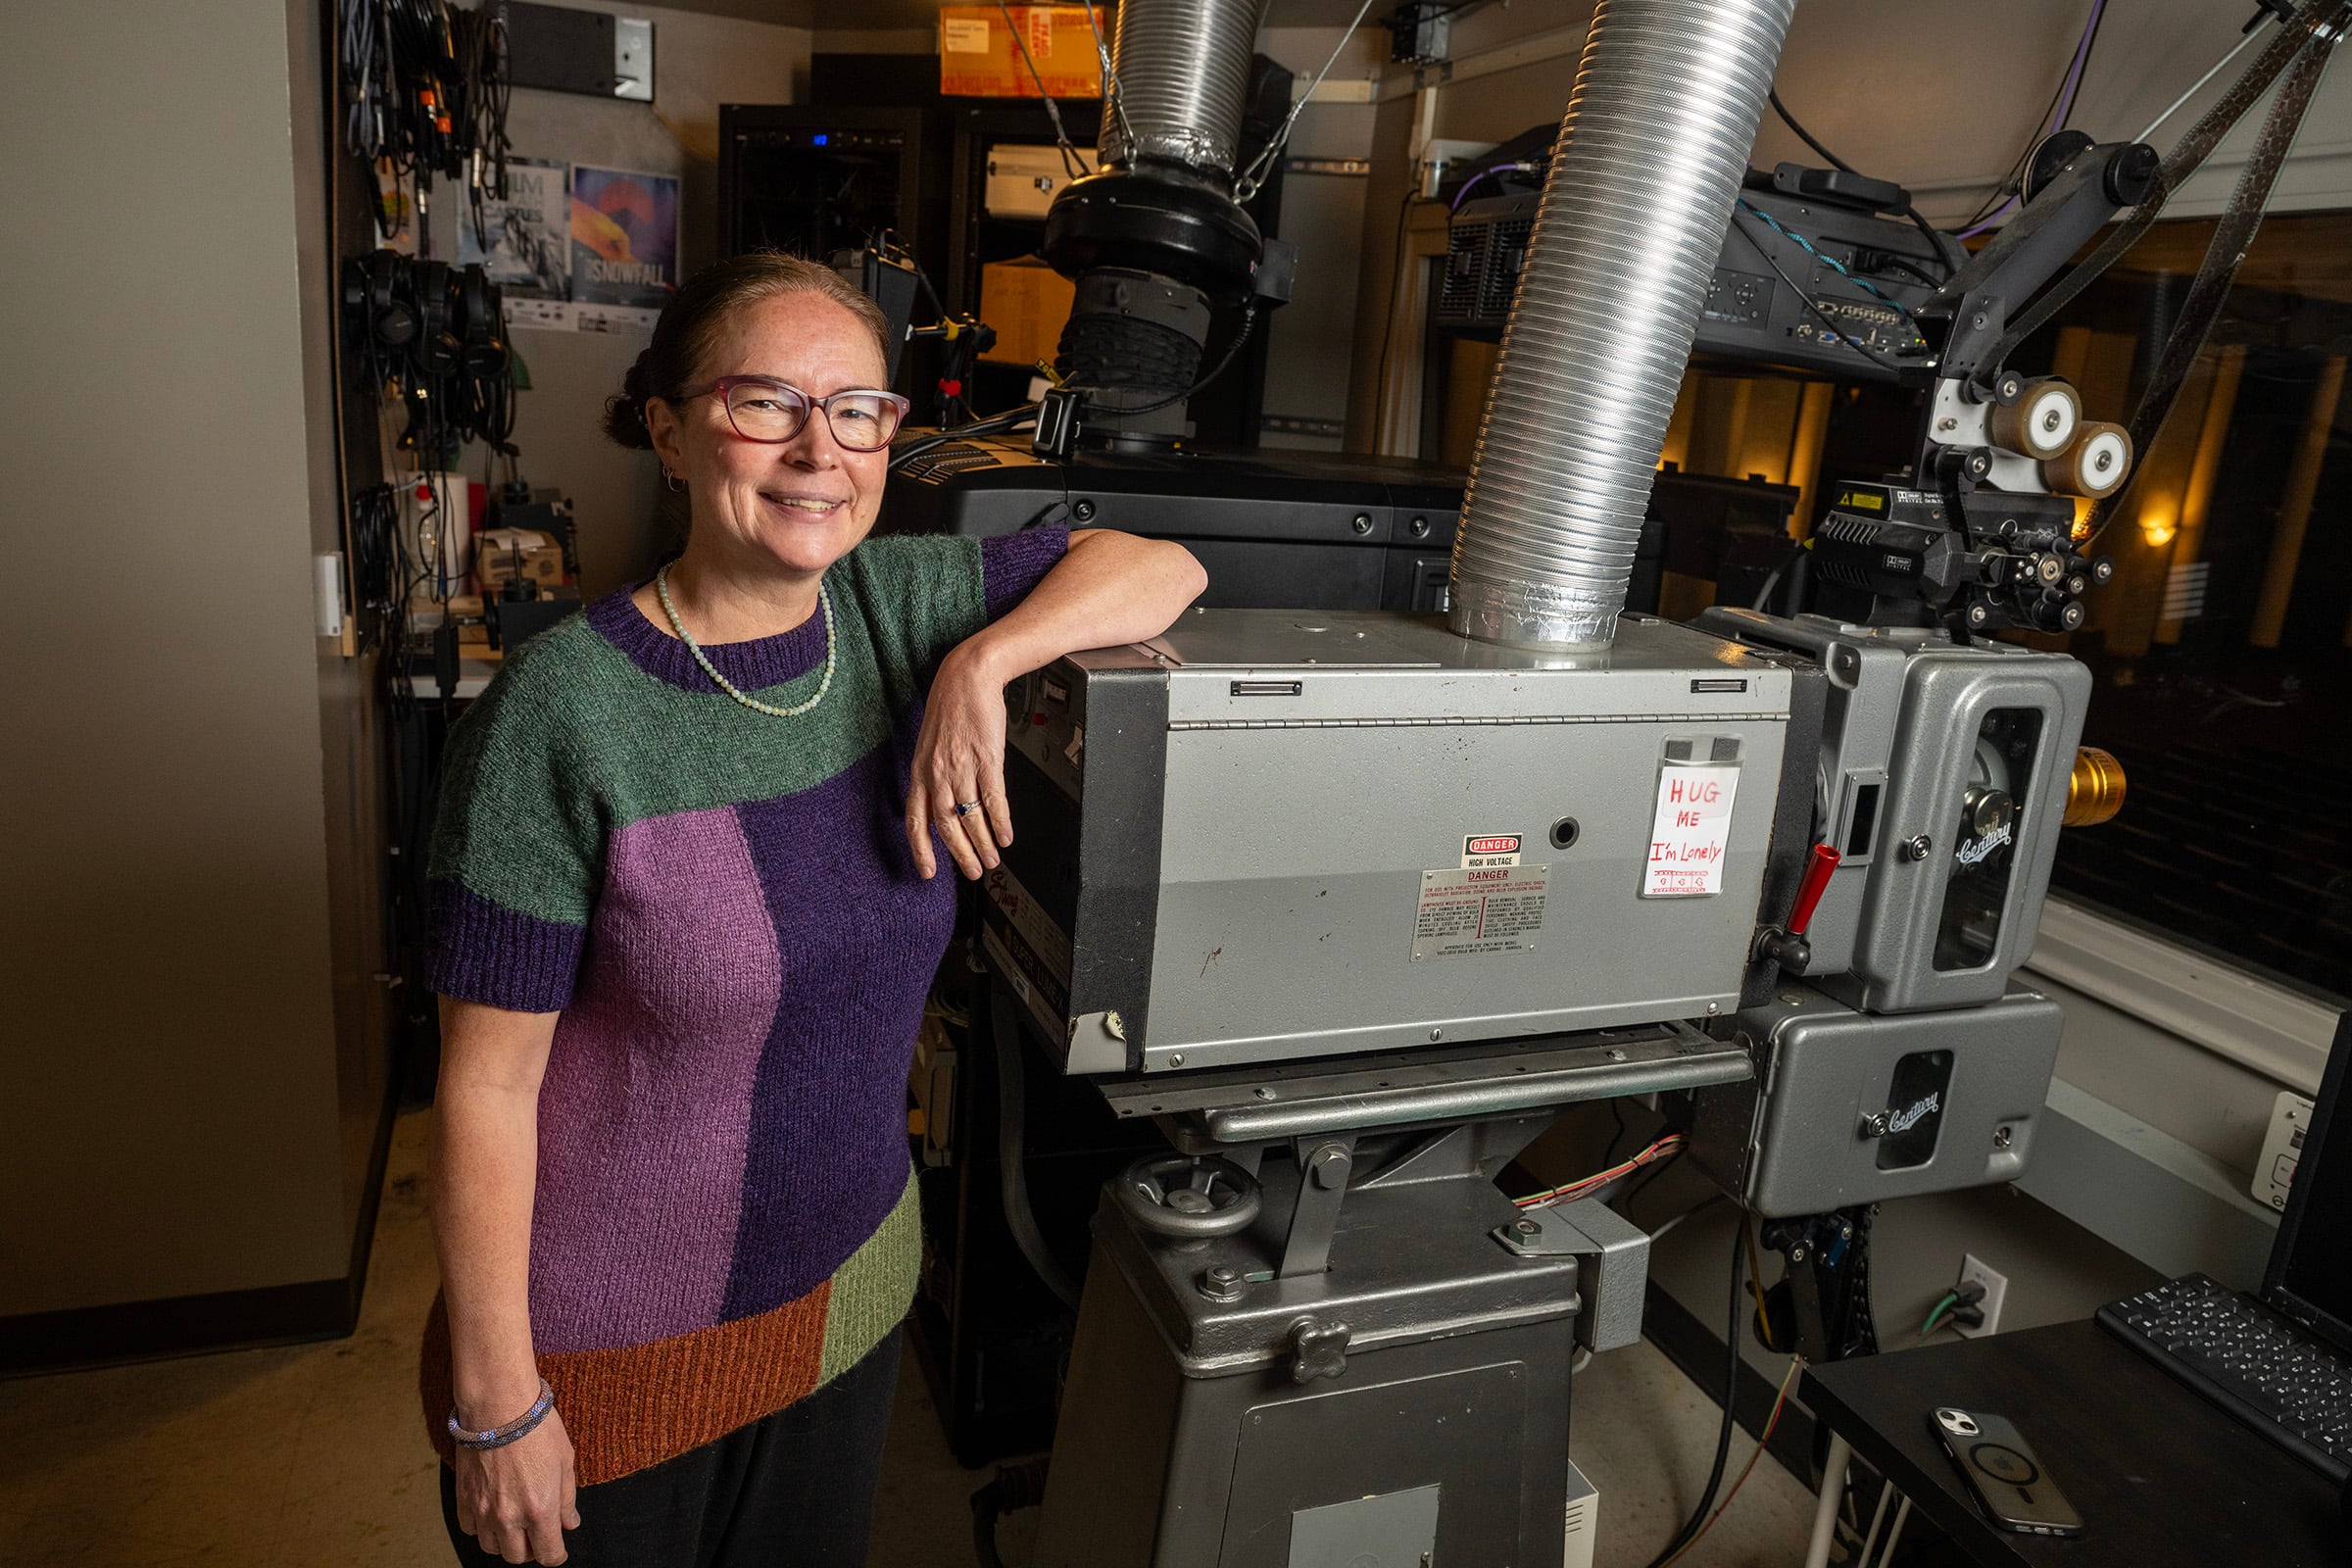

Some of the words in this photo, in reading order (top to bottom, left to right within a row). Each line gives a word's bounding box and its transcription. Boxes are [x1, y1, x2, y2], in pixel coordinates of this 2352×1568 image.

[1670, 778, 1722, 803] HUG
[1677, 809, 1701, 828] ME
[1473, 840, 1515, 851] DANGER
[1650, 843, 1677, 861] I'm
[1681, 840, 1722, 862] Lonely
[1955, 821, 2012, 864] Century
[1487, 857, 1513, 865] VOLTAGE
[1468, 869, 1509, 880] DANGER
[1888, 1091, 1939, 1134] Century
